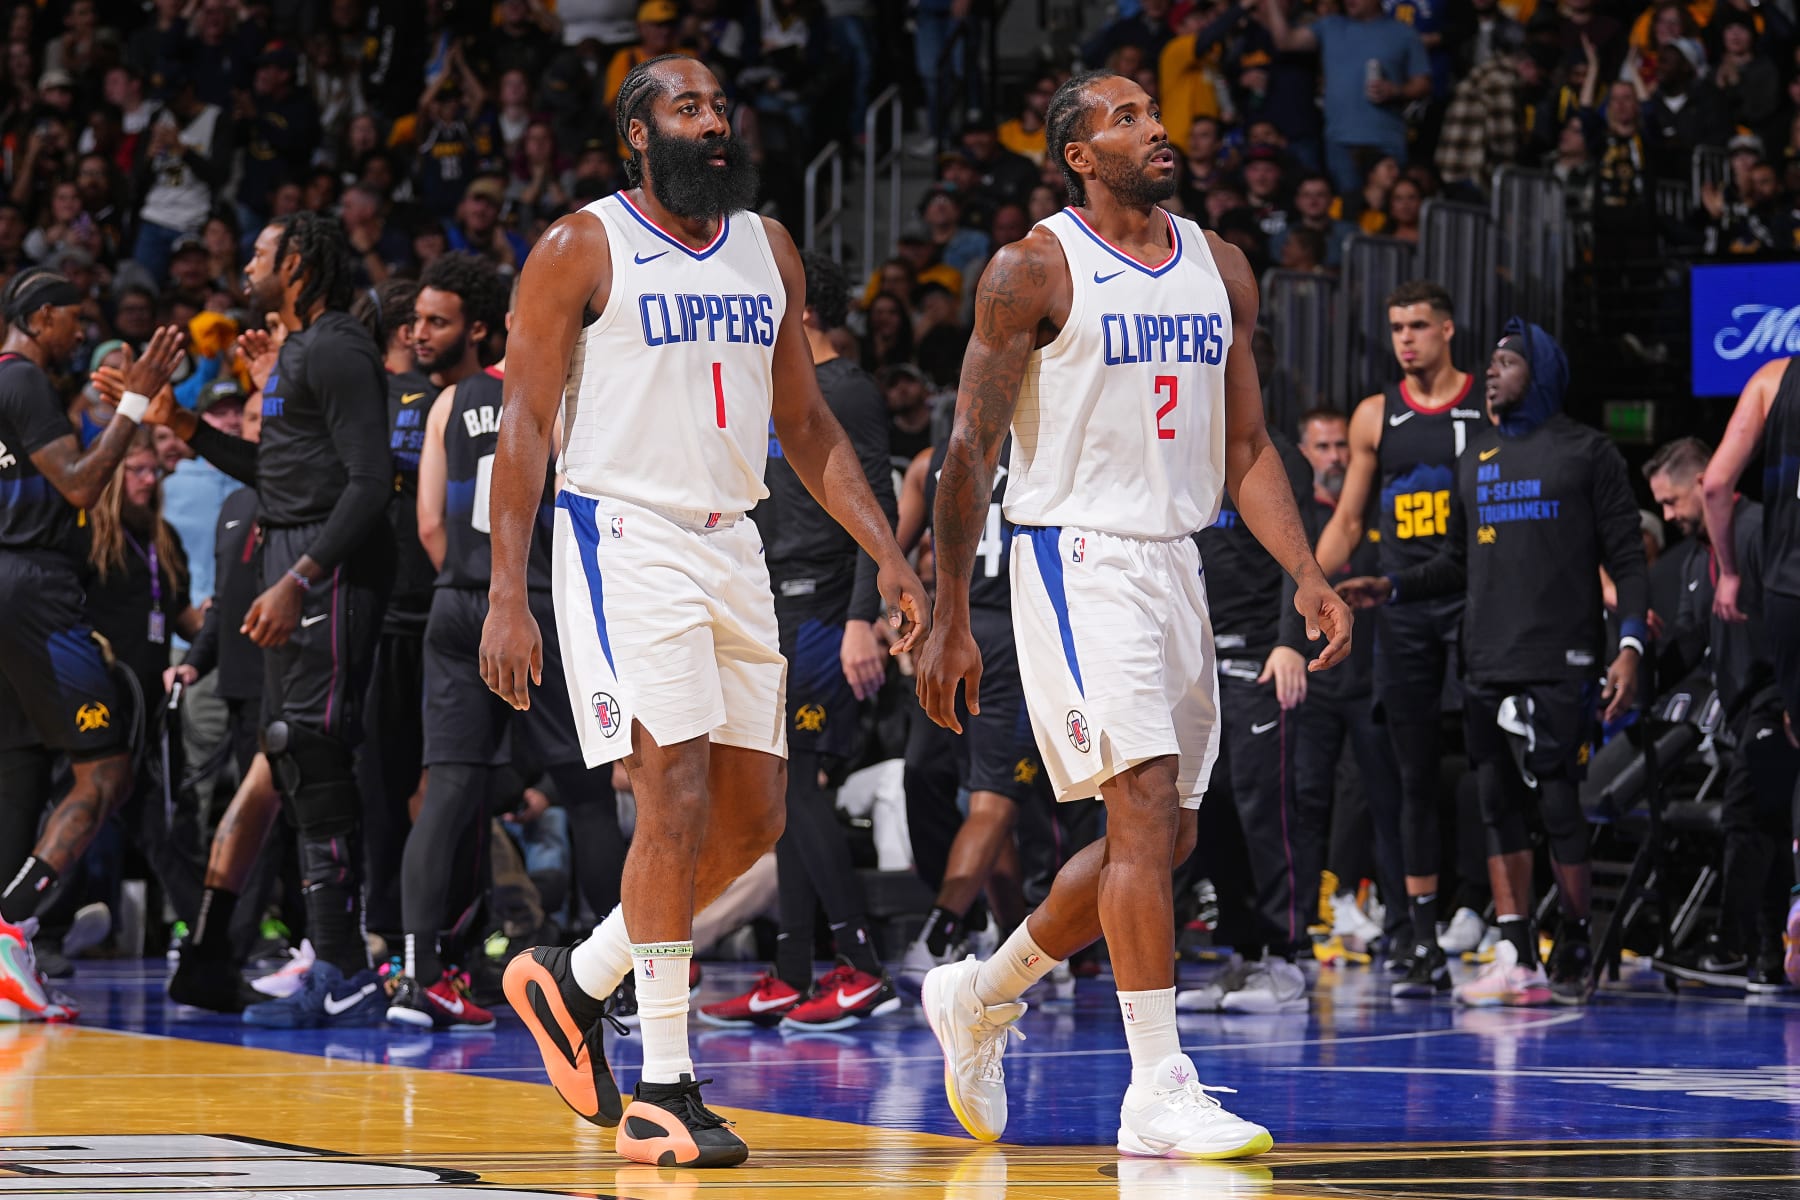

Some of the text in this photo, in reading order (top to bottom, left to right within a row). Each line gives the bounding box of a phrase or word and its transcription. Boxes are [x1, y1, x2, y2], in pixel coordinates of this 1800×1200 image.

[638, 293, 775, 347] CLIPPERS
[1100, 313, 1223, 366] CLIPPERS
[711, 362, 726, 428] 1
[1154, 375, 1177, 440] 2
[1477, 463, 1500, 482] NBA
[1477, 479, 1541, 504] IN-SEASON
[1478, 501, 1560, 524] TOURNAMENT
